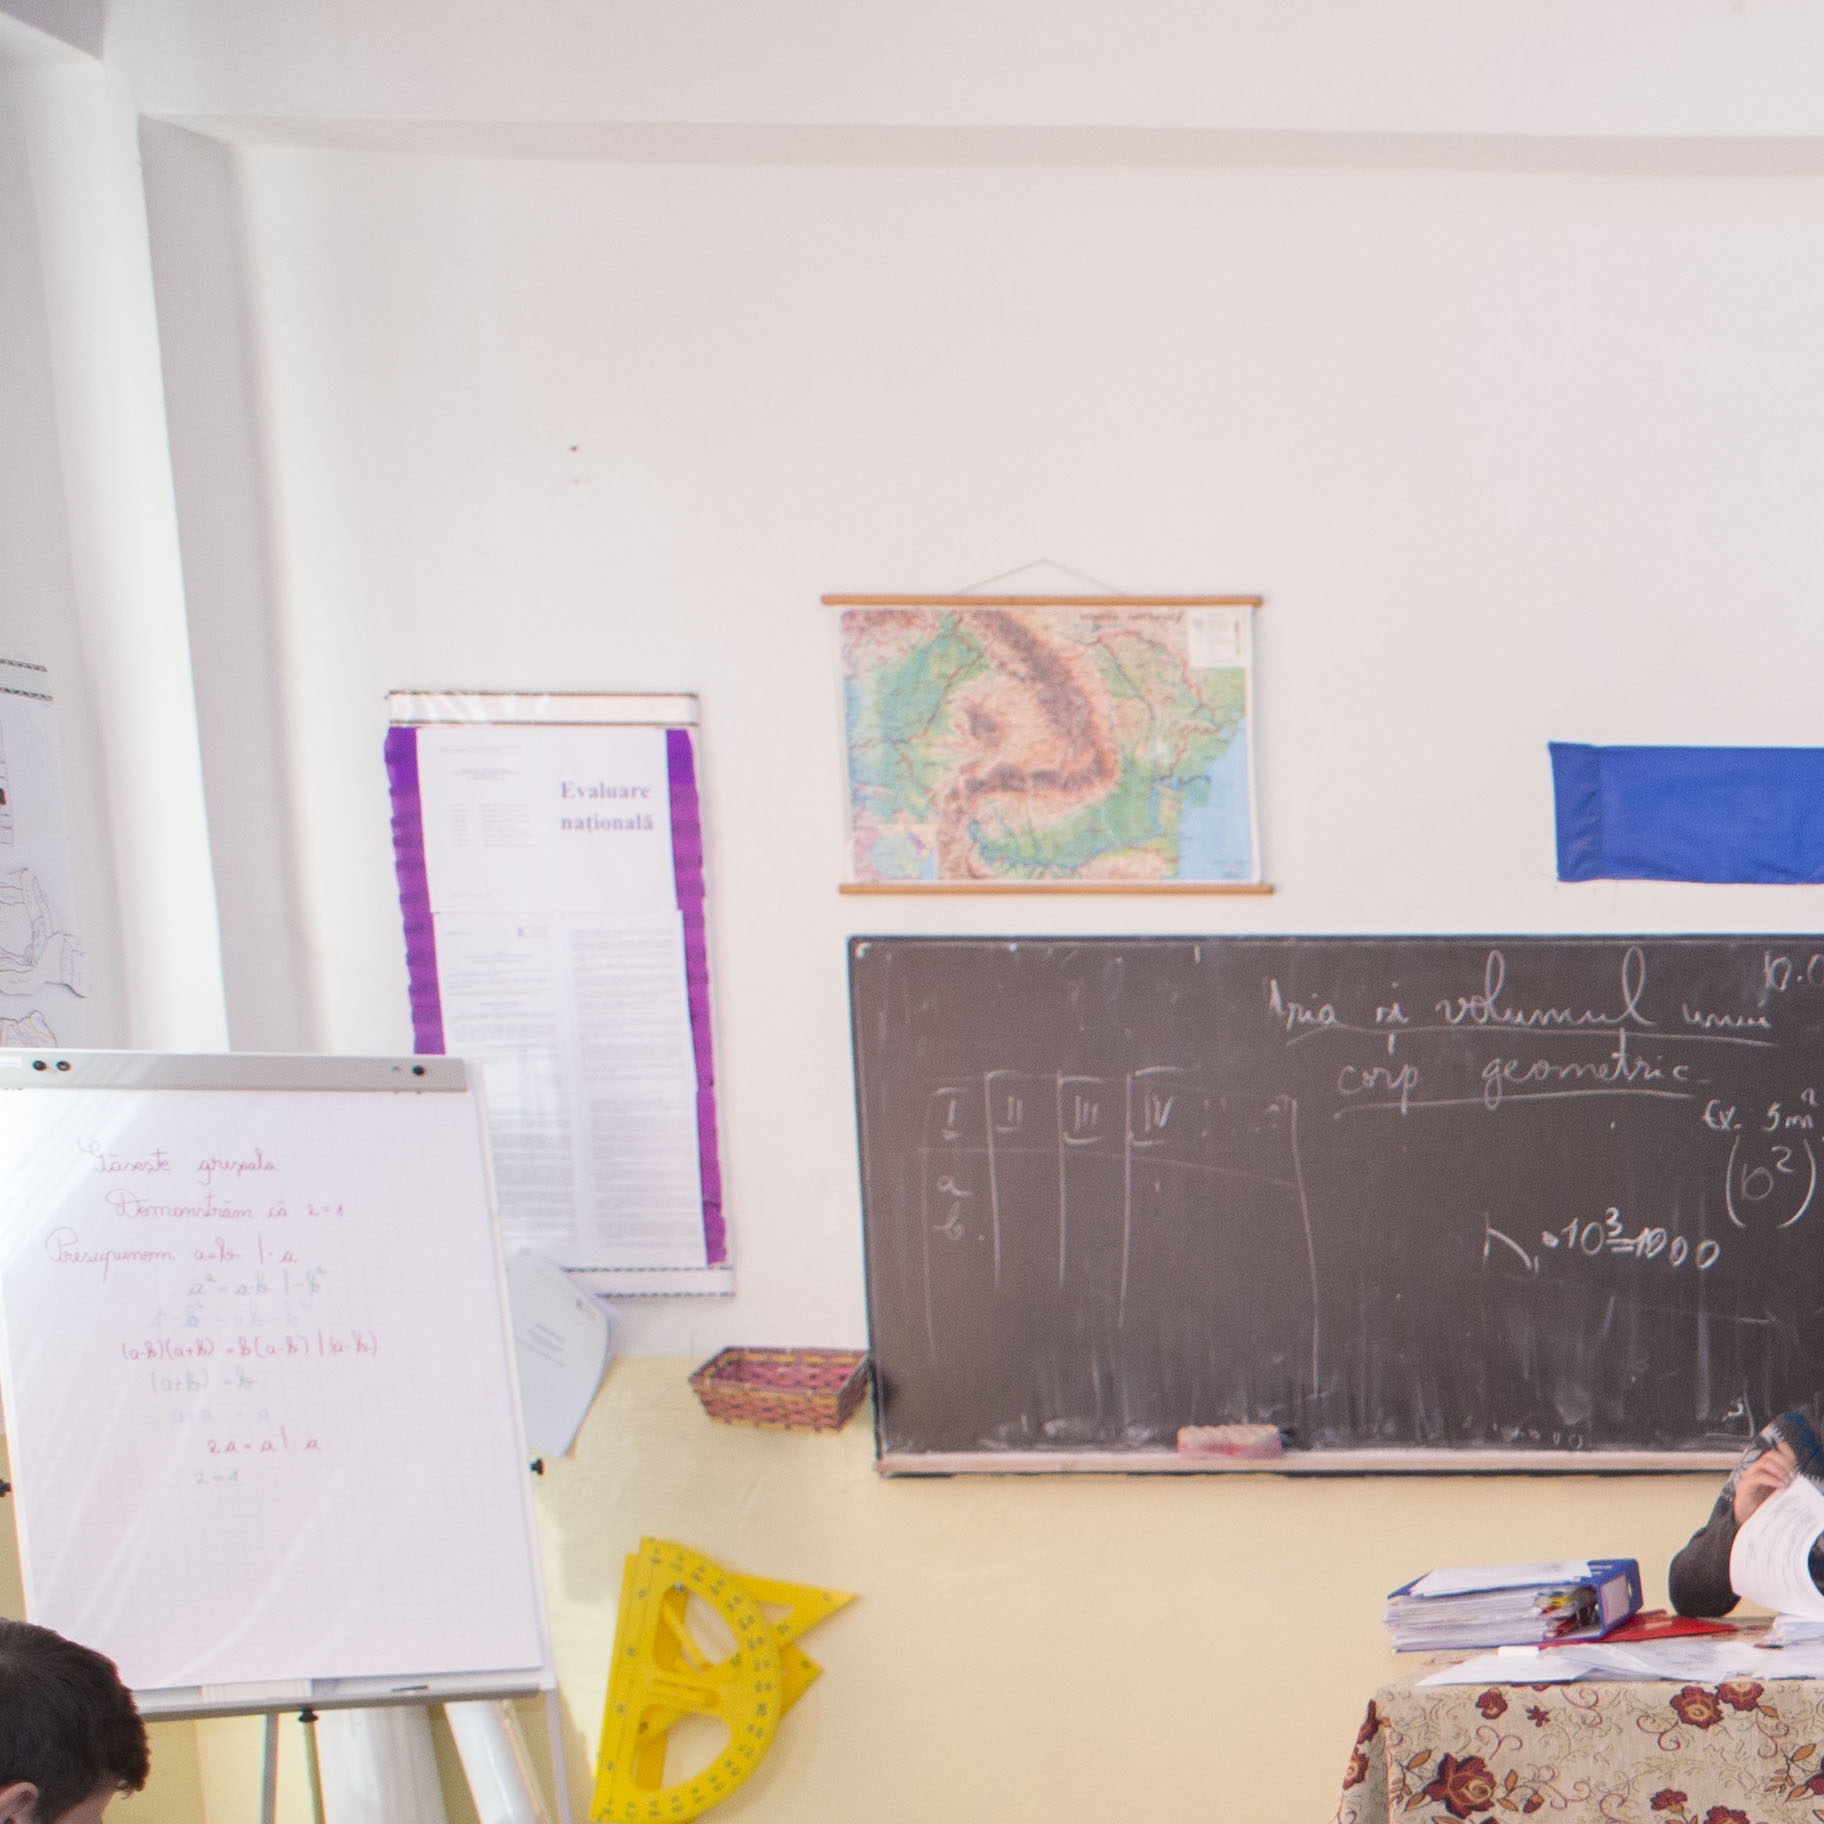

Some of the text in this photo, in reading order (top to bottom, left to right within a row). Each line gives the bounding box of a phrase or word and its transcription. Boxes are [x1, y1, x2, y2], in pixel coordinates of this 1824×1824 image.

[560, 780, 653, 800] Evaluare
[1435, 948, 1655, 1026] volumul
[1337, 1027, 1691, 1116] corp geometric
